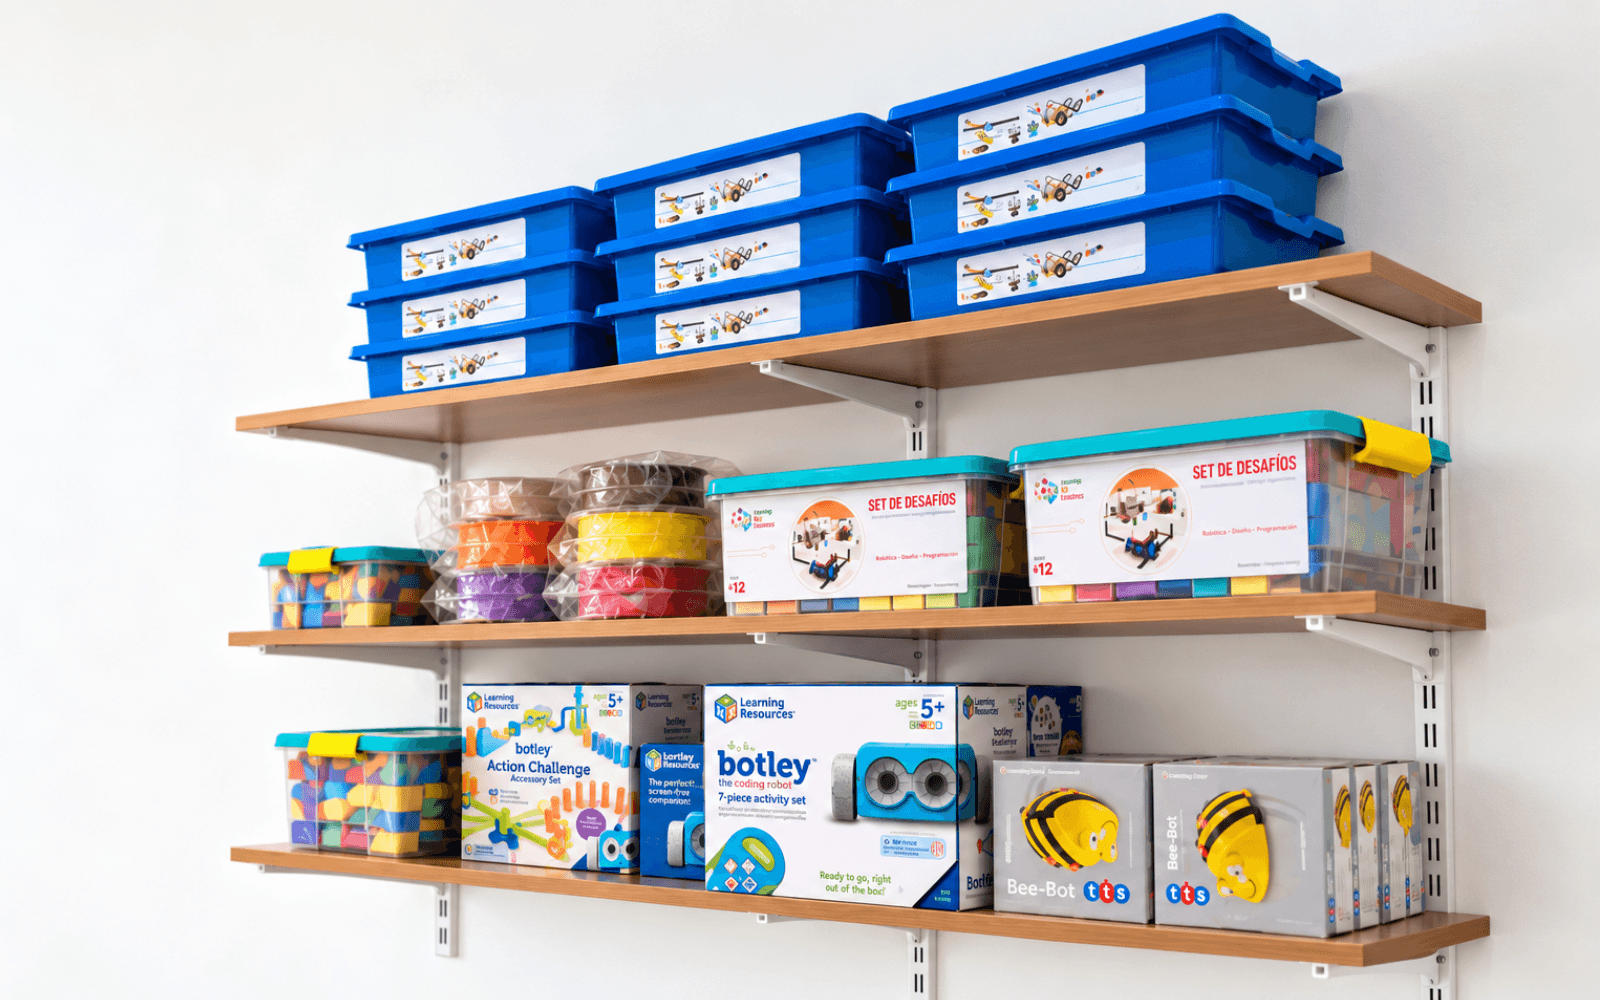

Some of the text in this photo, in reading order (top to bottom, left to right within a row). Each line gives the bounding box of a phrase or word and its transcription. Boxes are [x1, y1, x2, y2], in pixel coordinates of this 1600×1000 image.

[1192, 453, 1297, 480] SET DE DESAFÍOS
[868, 490, 956, 512] SET DE DESAFÍOS
[484, 694, 514, 703] Learning
[608, 693, 623, 708] 5+
[740, 697, 784, 710] Learning
[484, 702, 519, 710] Resources
[895, 698, 945, 719] ages 5+
[740, 708, 794, 719] Resources
[515, 742, 551, 758] botley
[487, 760, 591, 778] Action Challenge
[717, 749, 811, 786] botley
[510, 774, 561, 785] Accessory Set
[648, 778, 662, 786] The
[718, 778, 792, 790] the coding robot
[718, 792, 806, 806] 7-piece activity set
[1166, 815, 1179, 871] Bee-Bot
[819, 871, 891, 885] Ready to go, right
[825, 884, 838, 892] out
[840, 884, 849, 893] of
[852, 885, 865, 895] the
[1007, 878, 1128, 902] Bee-Bot tts
[1168, 884, 1207, 904] tts
